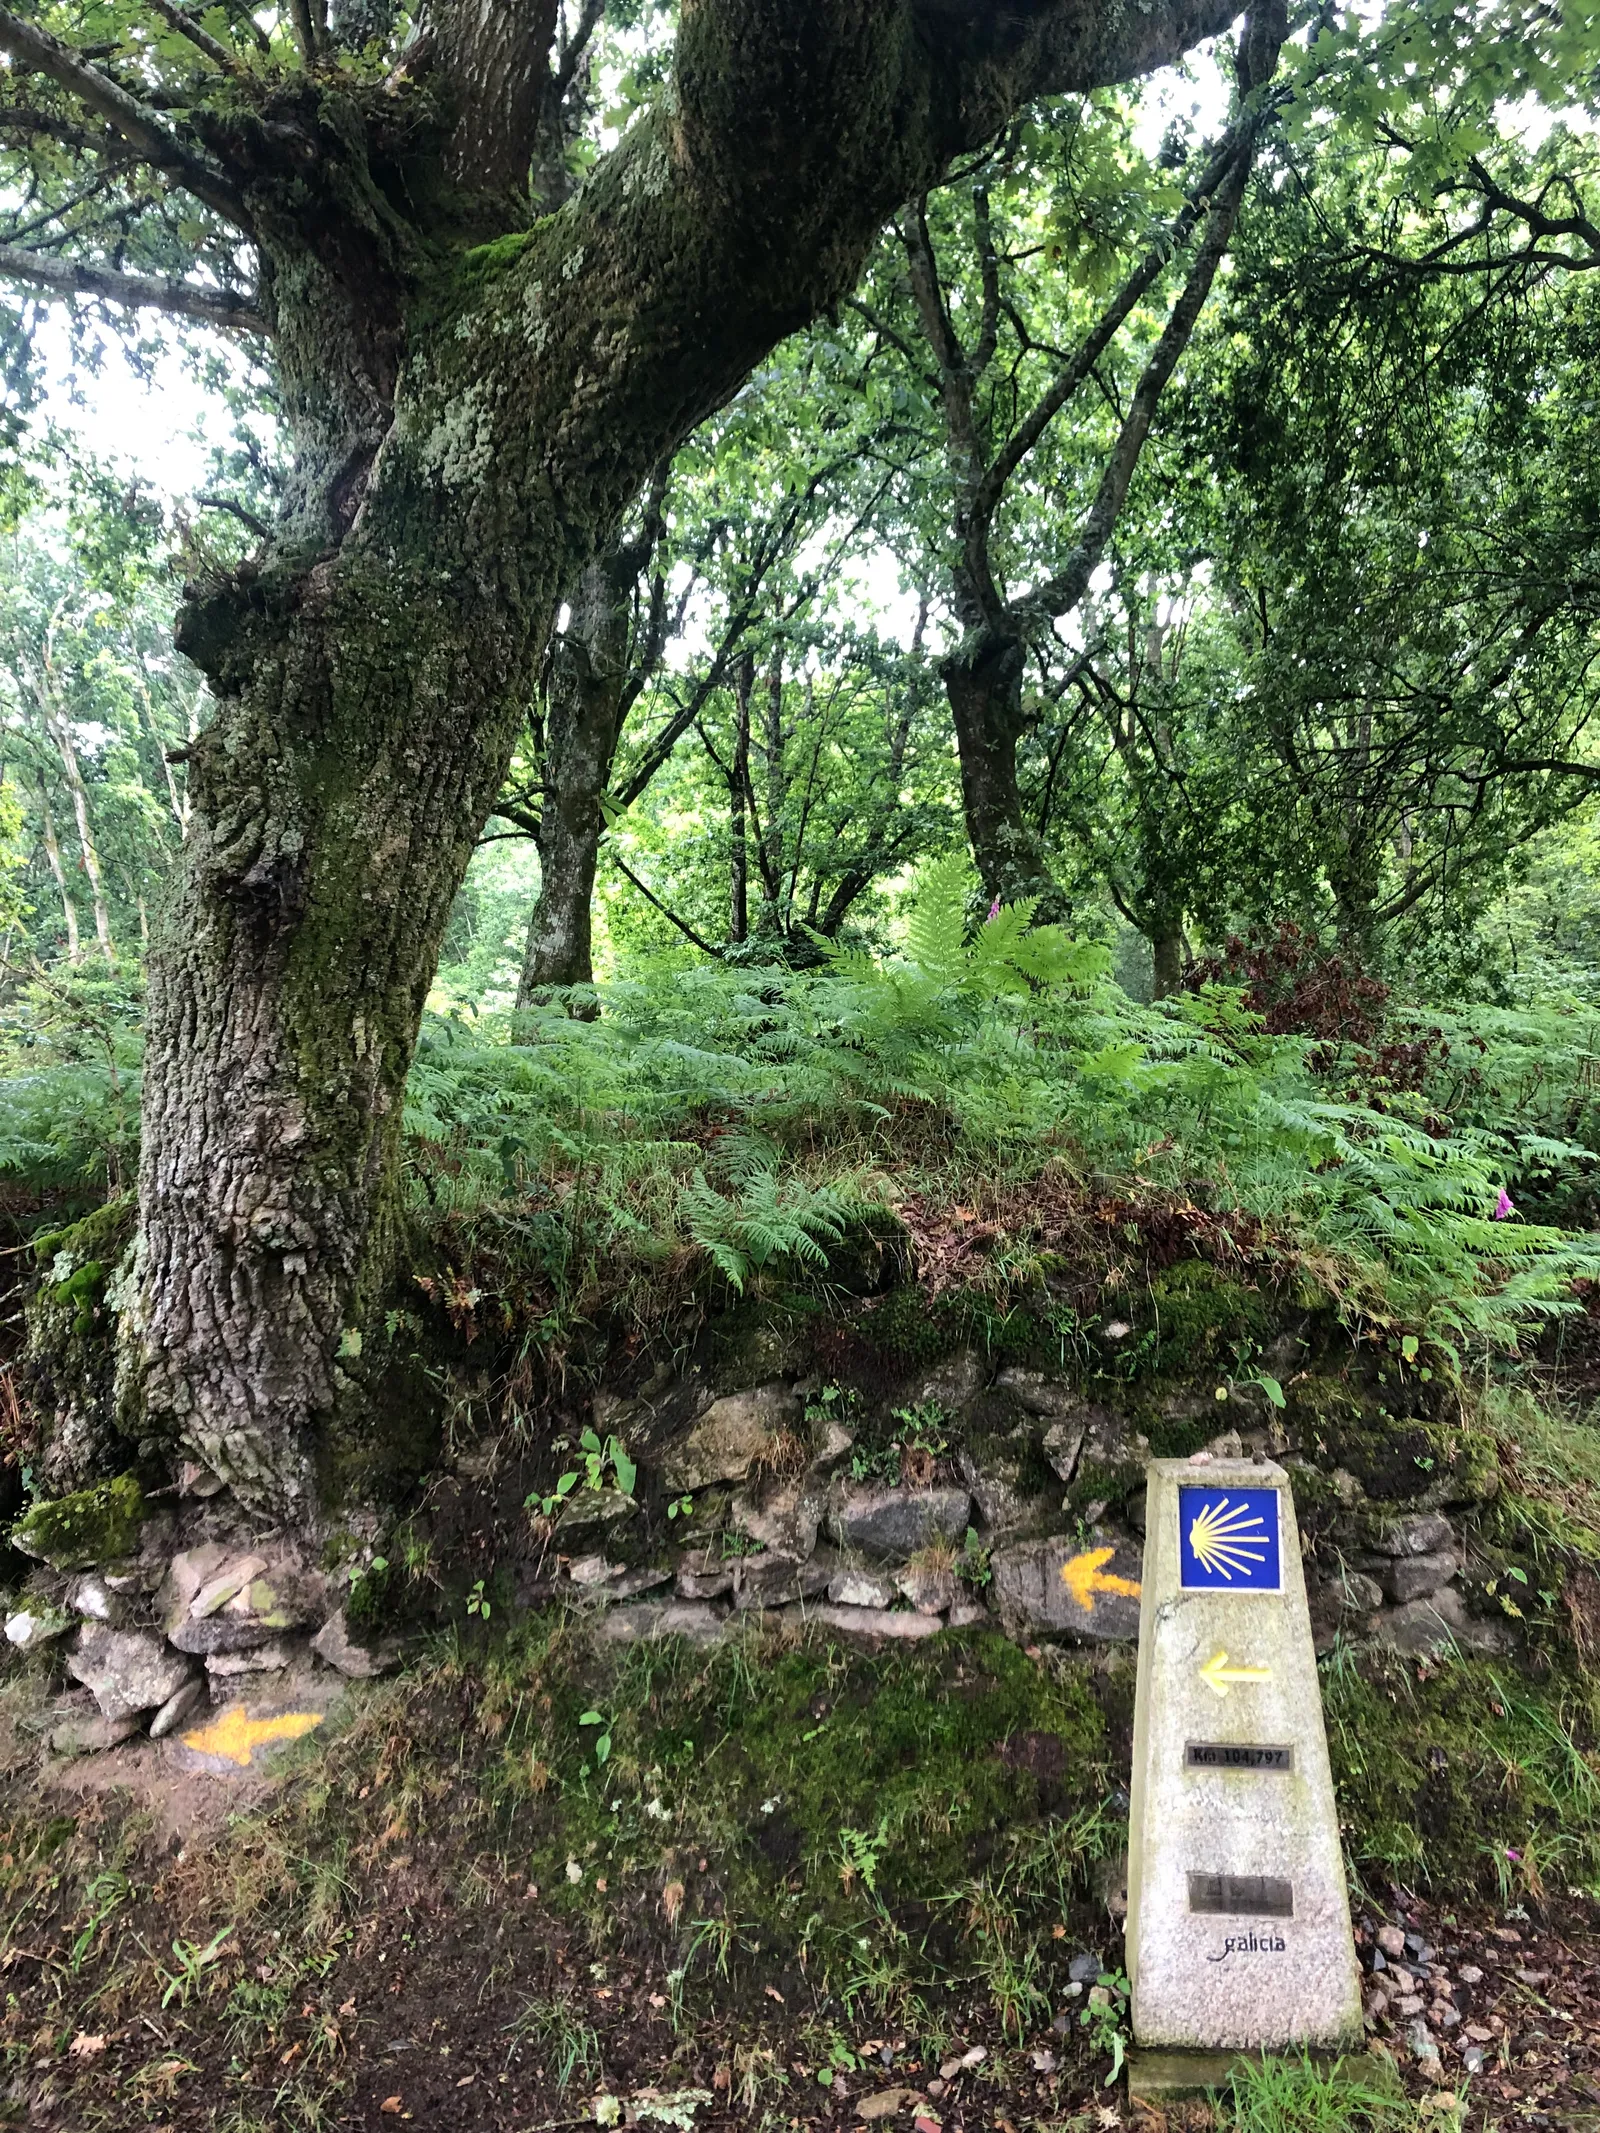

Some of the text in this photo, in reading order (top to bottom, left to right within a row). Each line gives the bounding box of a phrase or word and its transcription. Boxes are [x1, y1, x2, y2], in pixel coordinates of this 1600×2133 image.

[1193, 1748, 1283, 1766] Km 104,797
[1206, 1931, 1285, 1962] galicia
